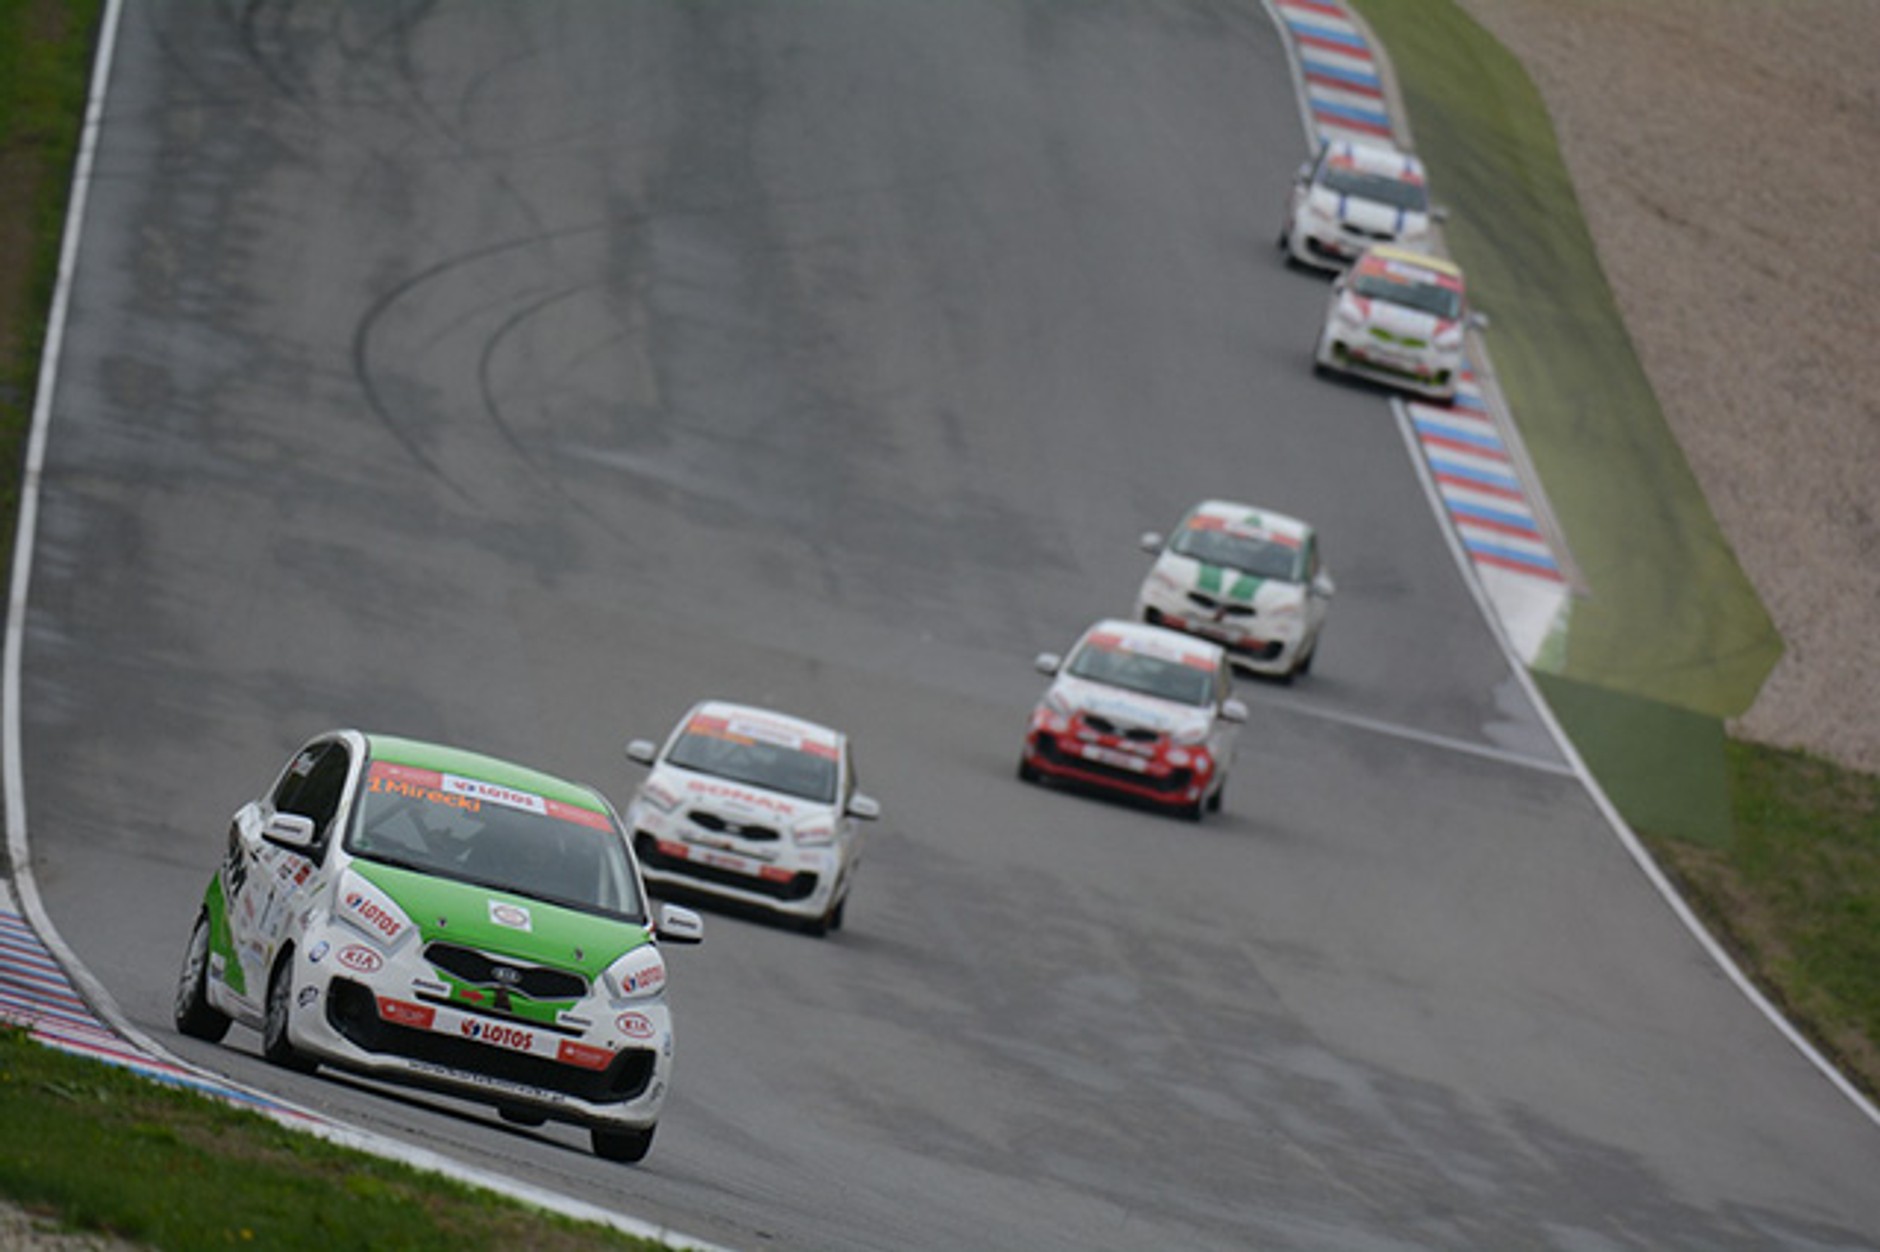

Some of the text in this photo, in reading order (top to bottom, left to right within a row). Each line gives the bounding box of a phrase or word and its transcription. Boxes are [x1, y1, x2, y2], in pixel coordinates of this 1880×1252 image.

[479, 784, 534, 807] LOTOS
[358, 899, 401, 936] LOTOS
[482, 1023, 533, 1050] LOTOS
